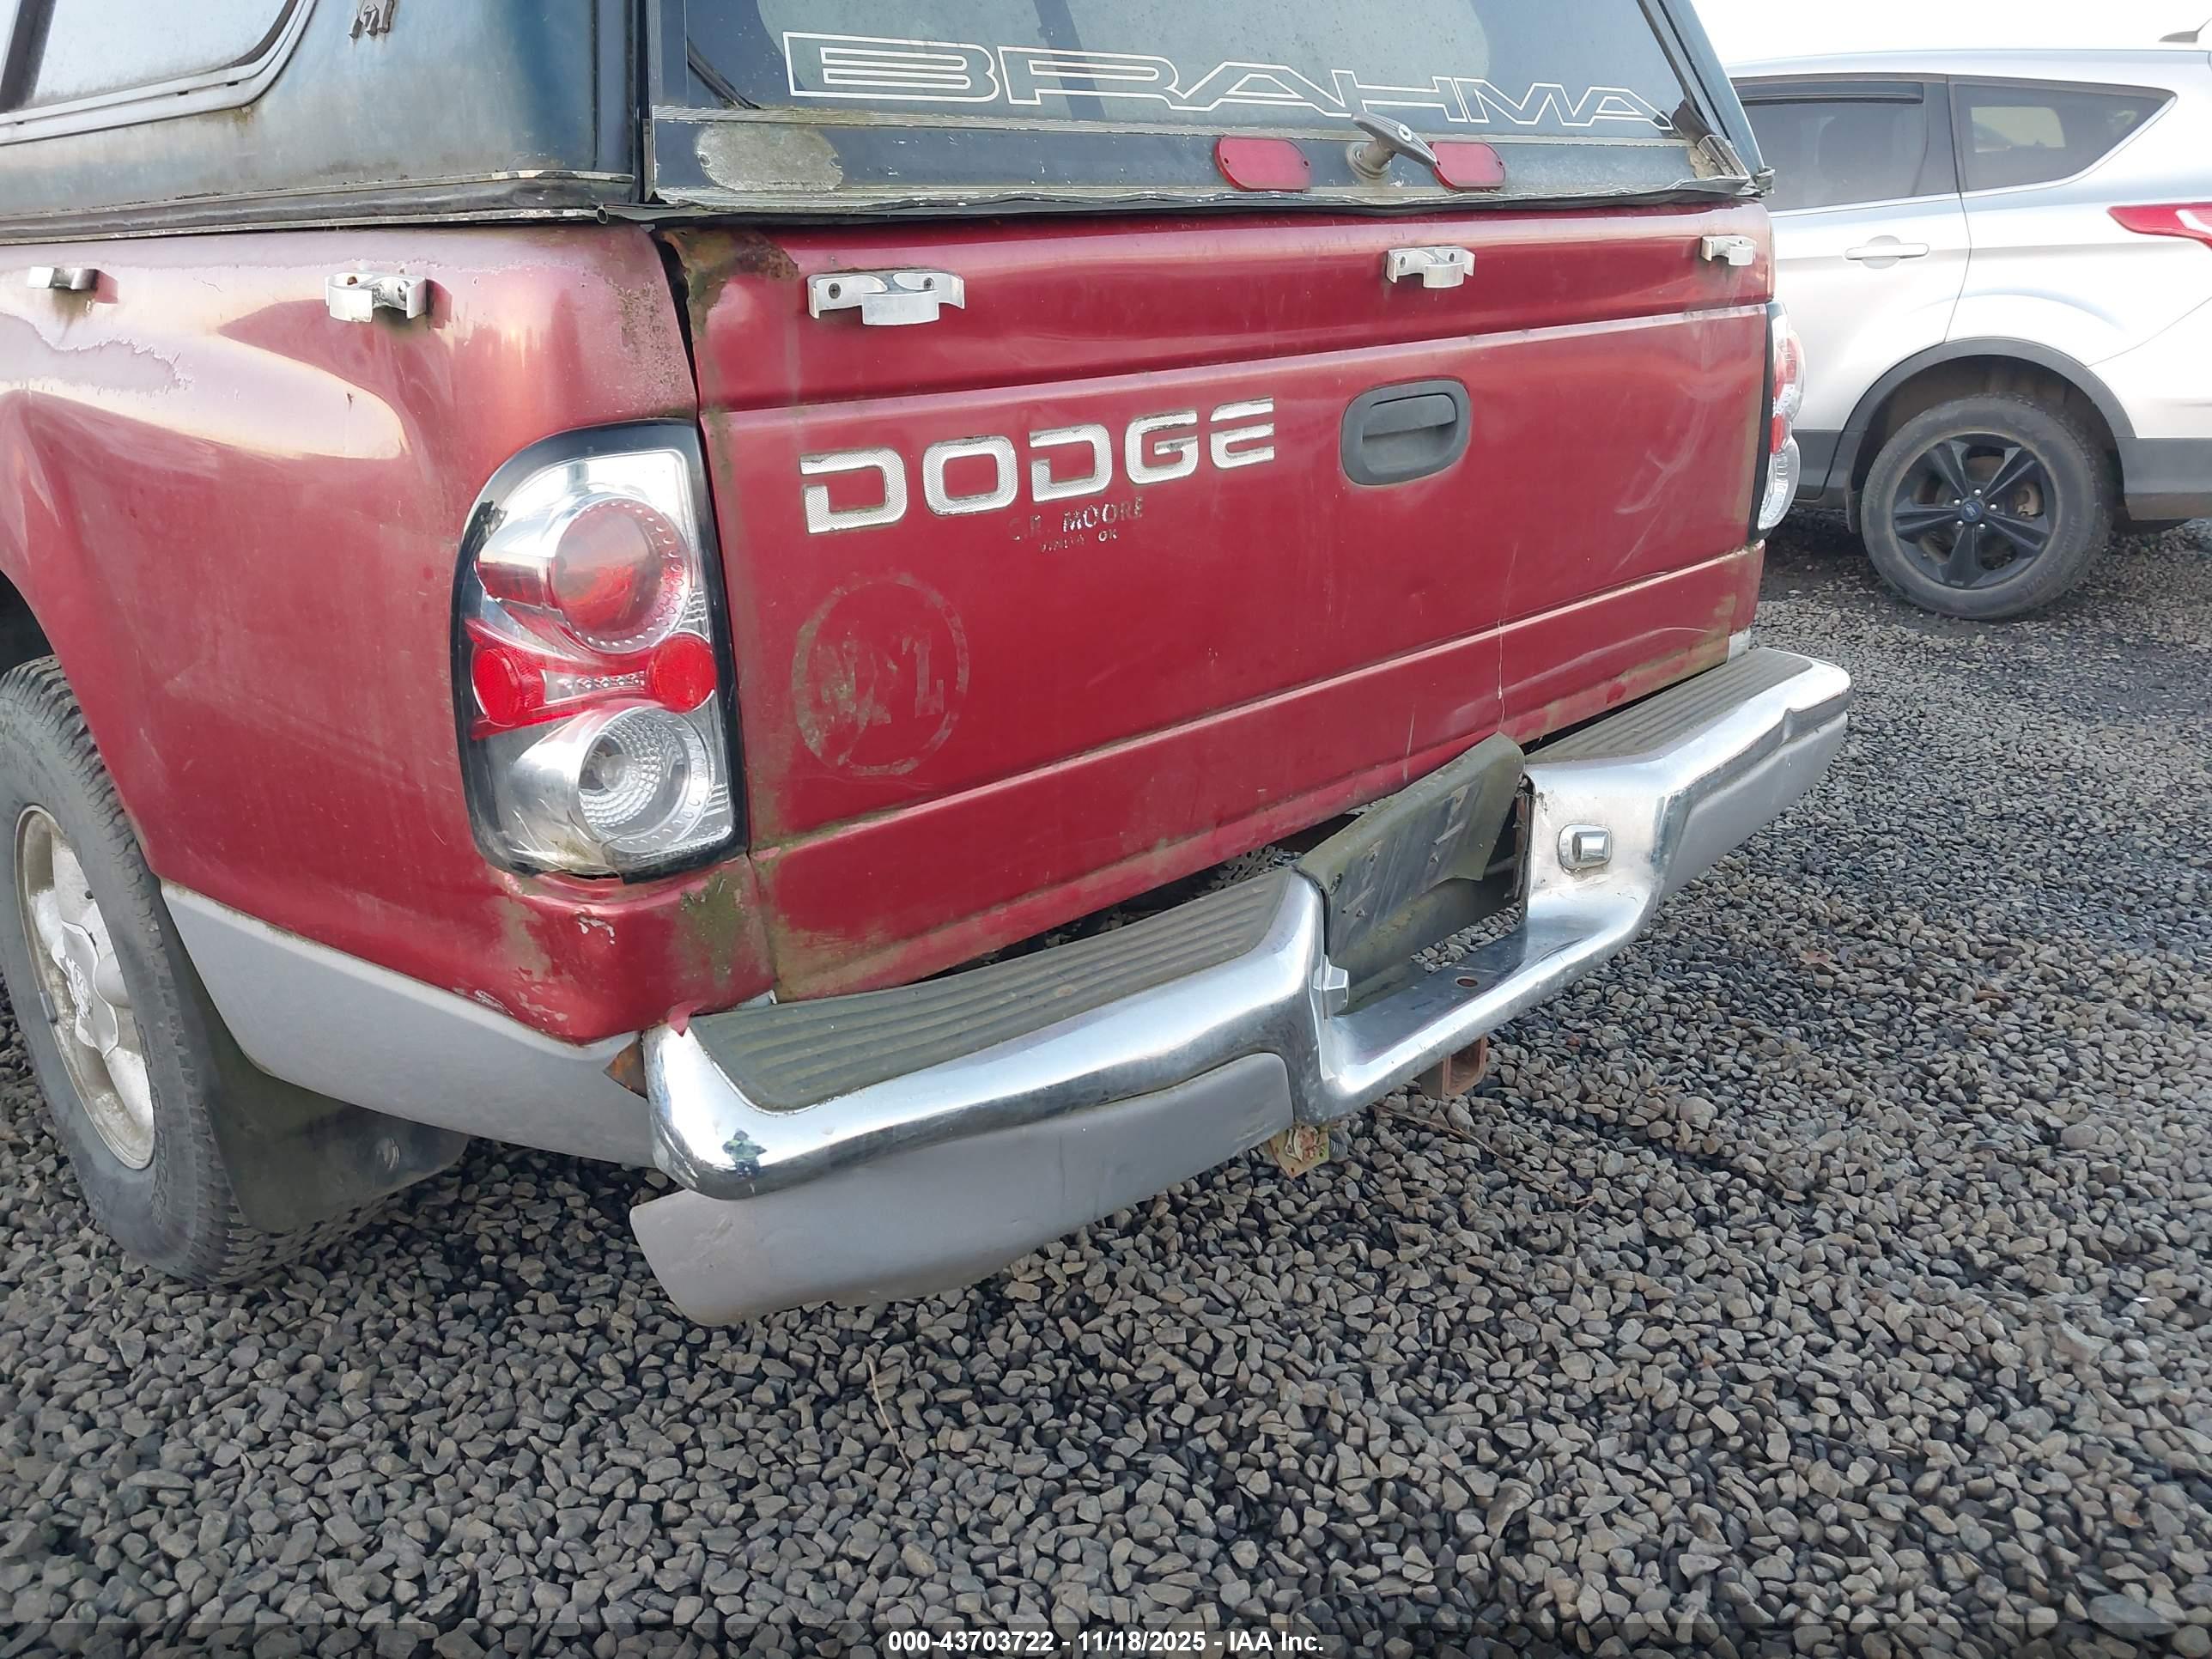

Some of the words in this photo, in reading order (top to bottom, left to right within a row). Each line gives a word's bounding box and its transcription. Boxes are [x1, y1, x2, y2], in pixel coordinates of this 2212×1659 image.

[782, 30, 1674, 131] BRAHMA
[799, 396, 1276, 535] DODGE
[1062, 495, 1144, 532] MOORE
